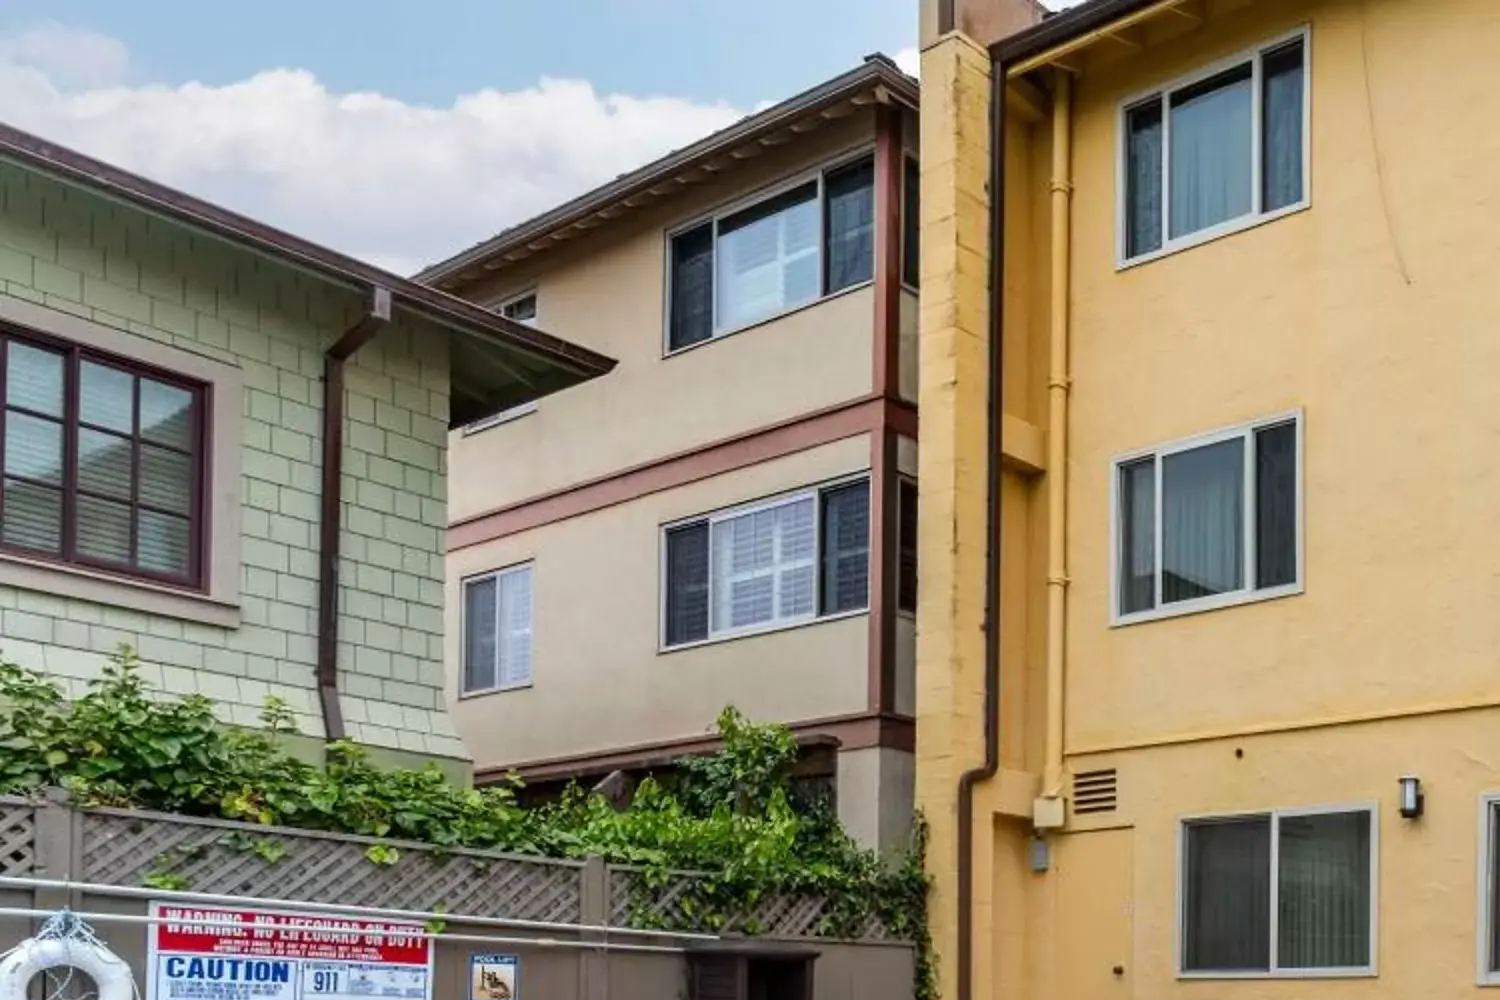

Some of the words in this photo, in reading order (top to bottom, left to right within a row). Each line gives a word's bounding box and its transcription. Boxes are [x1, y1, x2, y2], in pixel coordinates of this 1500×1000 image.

[253, 914, 274, 939] NO
[279, 916, 360, 945] LIFEGUARD
[166, 956, 289, 983] CAUTION
[313, 971, 339, 993] 911
